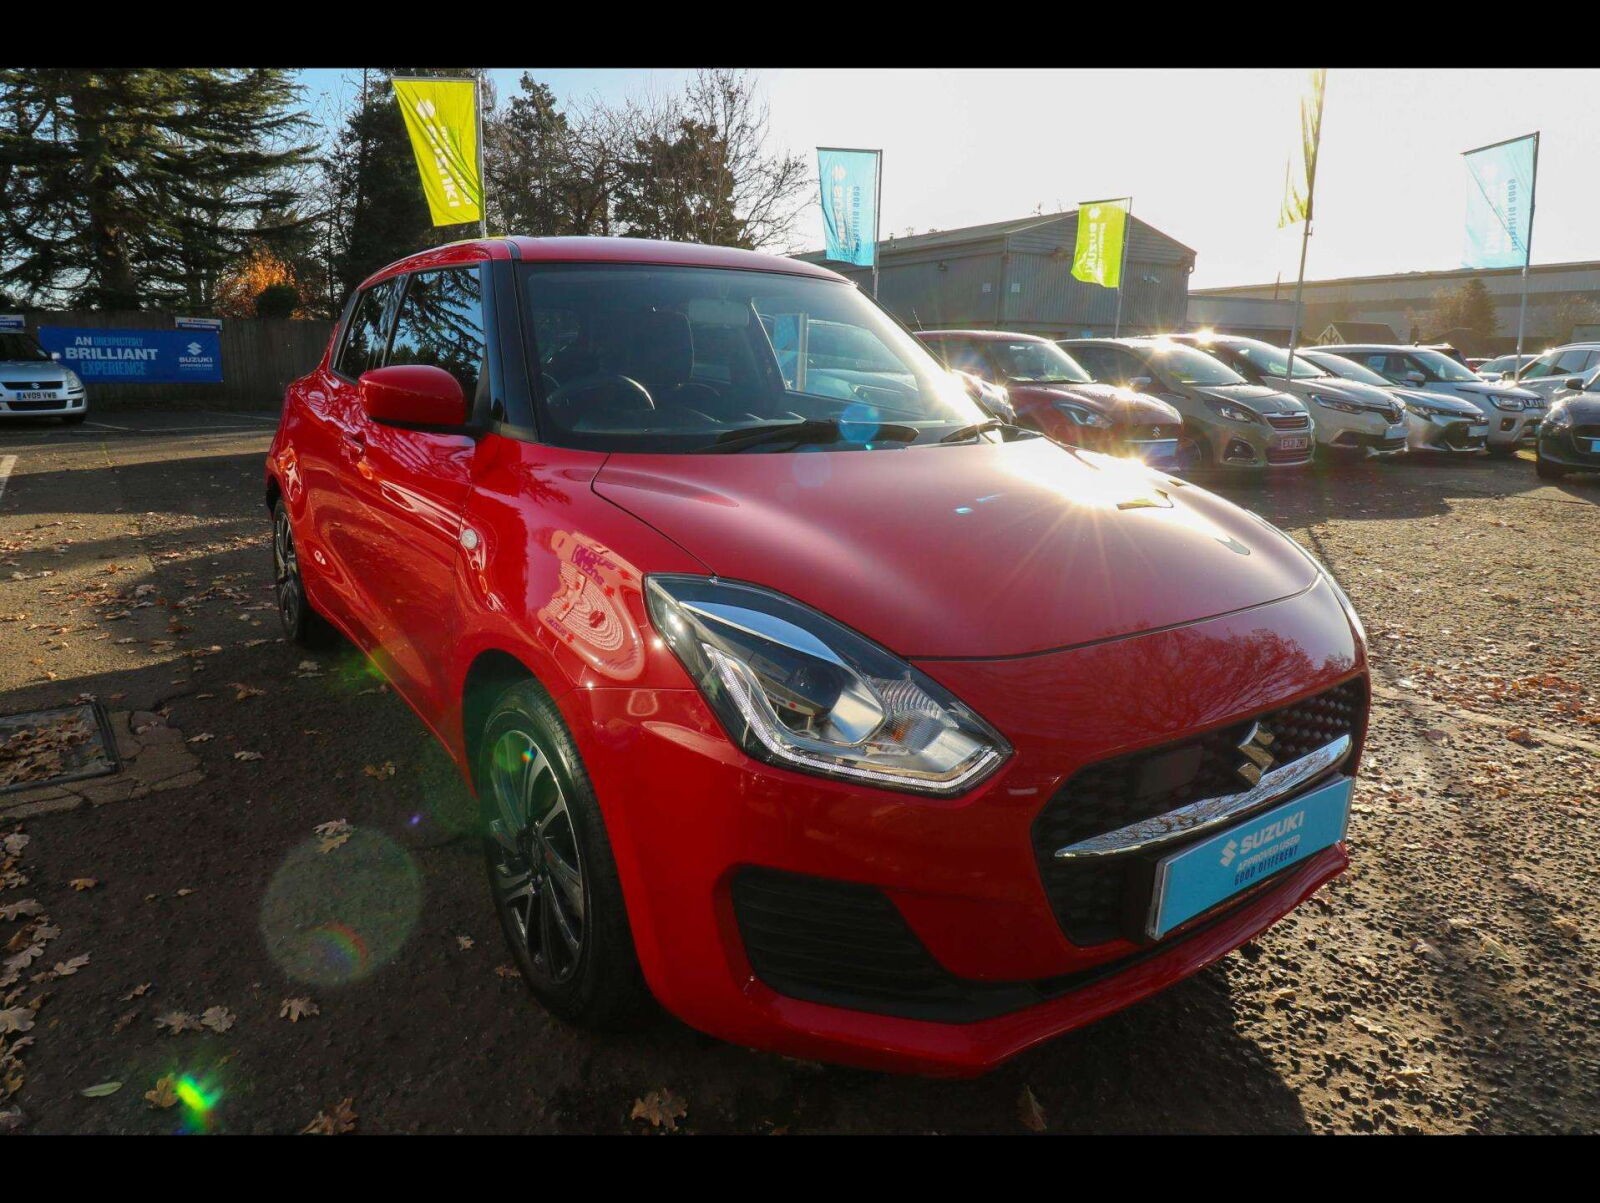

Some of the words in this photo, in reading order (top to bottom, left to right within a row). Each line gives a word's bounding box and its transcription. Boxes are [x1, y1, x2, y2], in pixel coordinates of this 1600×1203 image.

[75, 336, 92, 346] AN
[65, 347, 158, 361] BRILLIANT
[80, 361, 146, 376] EXPERIENCE
[1239, 811, 1304, 854] SUZUKI
[1234, 865, 1256, 885] GOOD
[1259, 845, 1297, 872] DIFFERENT
